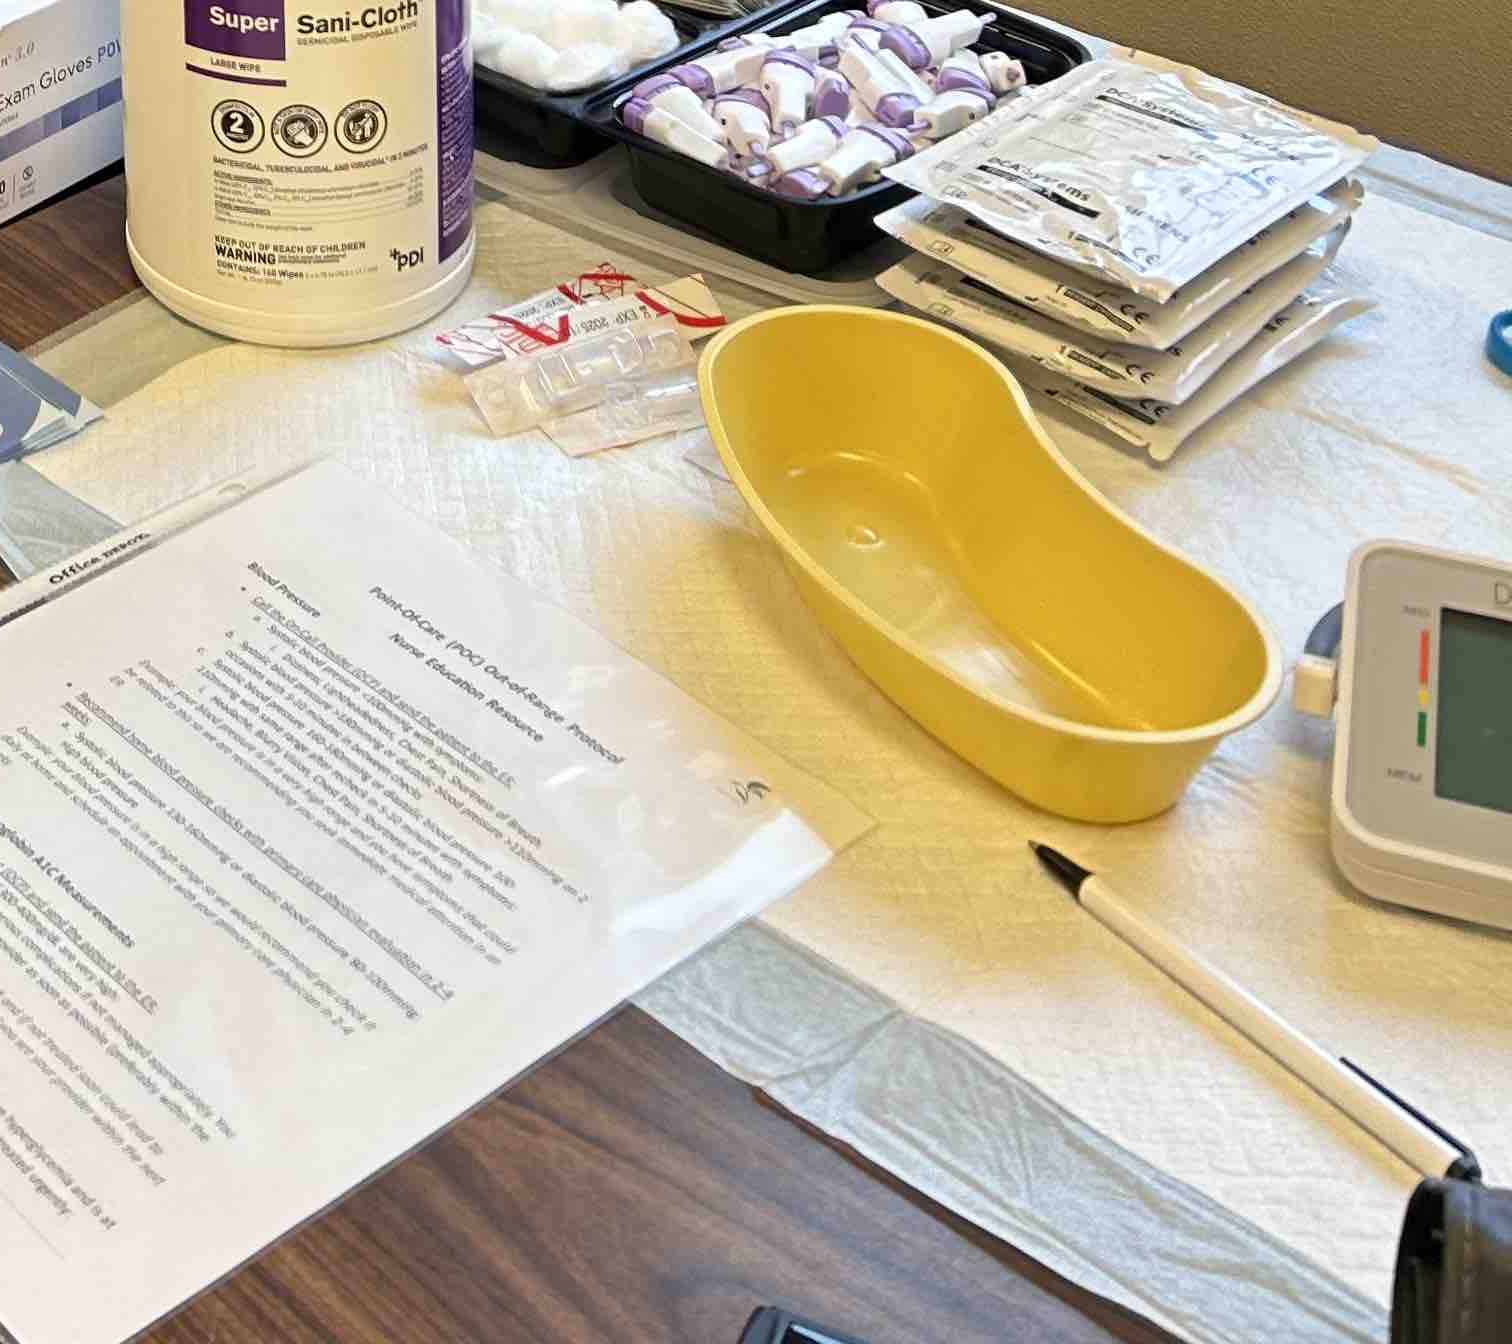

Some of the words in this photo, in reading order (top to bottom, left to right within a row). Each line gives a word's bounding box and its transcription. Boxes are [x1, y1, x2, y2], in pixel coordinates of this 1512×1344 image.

[210, 6, 280, 34] Super
[40, 54, 93, 90] Gloves
[229, 113, 244, 134] 2
[215, 234, 236, 247] KEEP
[240, 240, 257, 250] OUT
[273, 243, 303, 253] REACH
[320, 241, 366, 252] CHILDREN
[216, 245, 276, 265] WARNING
[243, 560, 281, 586] Blood
[274, 583, 324, 618] Pressure
[366, 585, 450, 642] Point-Of-Care
[444, 639, 487, 667] (POC)
[479, 663, 568, 724] Out-of-Range
[563, 722, 627, 766] Protocol
[387, 632, 429, 659] Nurse
[423, 657, 488, 701] Education
[482, 698, 547, 743] Resource
[28, 854, 60, 878] A1C
[50, 873, 139, 950] Measurements
